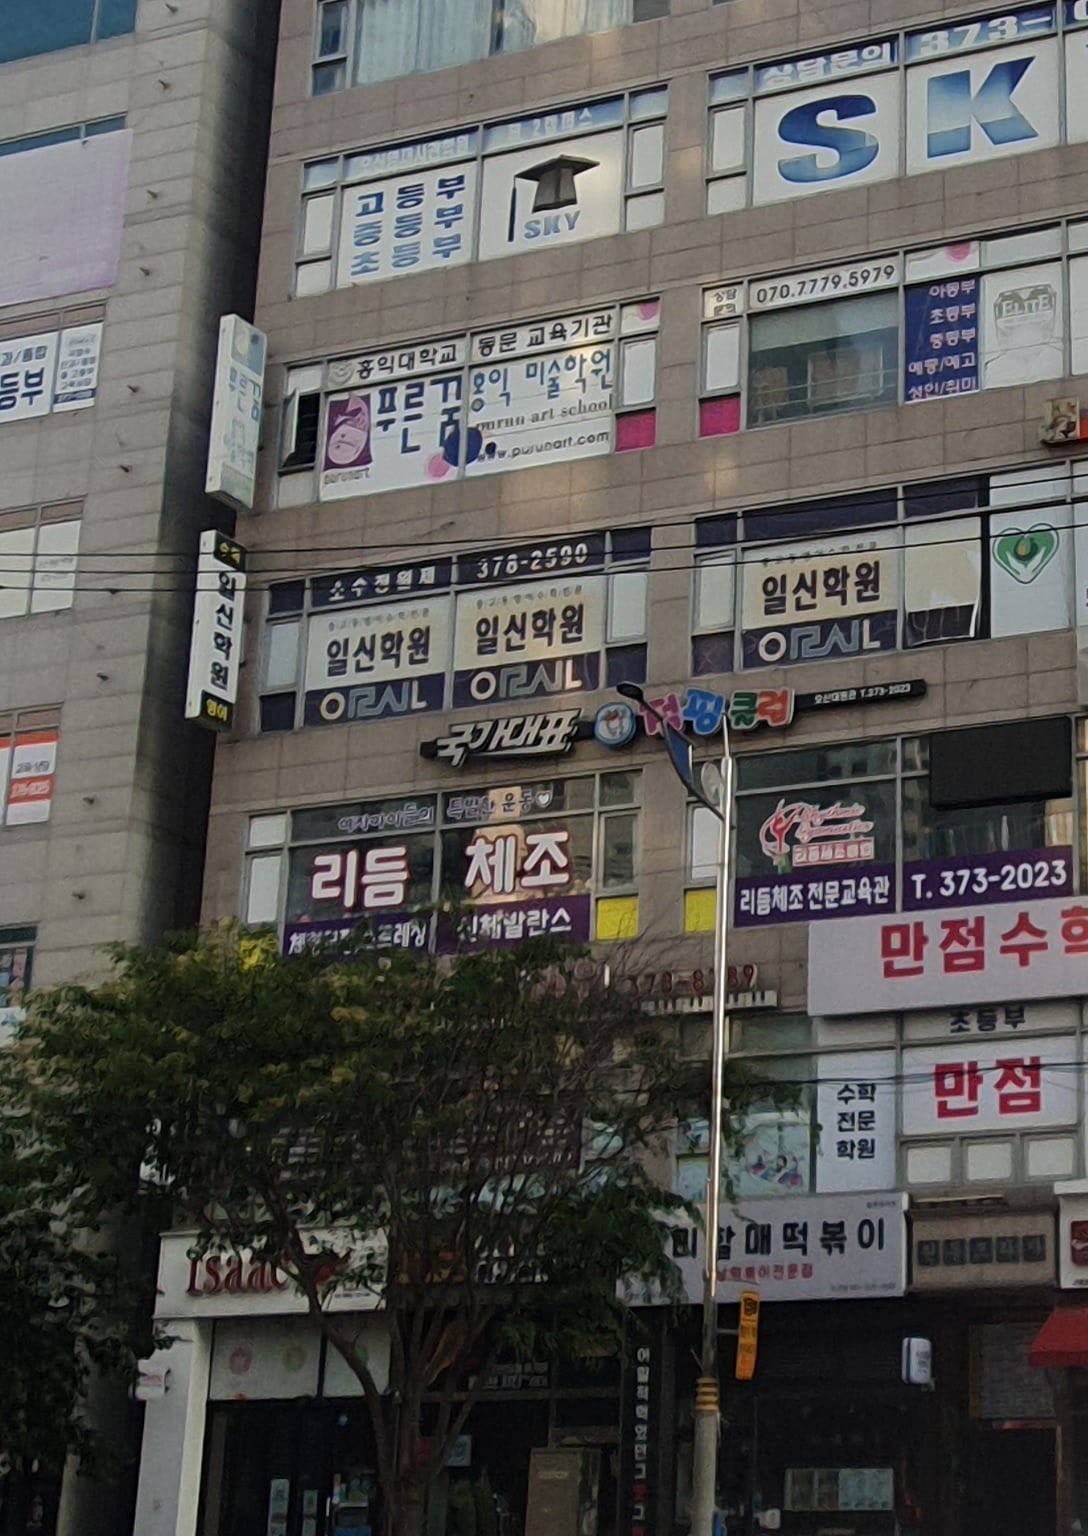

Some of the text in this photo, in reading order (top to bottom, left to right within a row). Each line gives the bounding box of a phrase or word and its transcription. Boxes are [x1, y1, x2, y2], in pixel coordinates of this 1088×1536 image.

[354, 173, 466, 218] 고등부
[353, 202, 465, 248] 중등부
[523, 209, 581, 241] SKY
[350, 231, 462, 277] 초등부
[356, 343, 458, 381] 홍익대학교
[526, 314, 614, 348] 교육기관
[525, 349, 613, 401] 미술학원
[530, 410, 555, 426] art
[560, 393, 614, 419] school
[760, 559, 883, 617] 일신학원
[325, 625, 431, 678] 일신학원
[474, 603, 586, 657] 일신학원
[434, 708, 584, 768] 국가대표
[310, 830, 571, 910] 리듬 체조
[939, 859, 1068, 899] 373-2023
[740, 874, 891, 916] 리듬체조 전문교육관
[948, 1004, 1028, 1034] 초등부
[836, 1081, 878, 1105] 수학
[932, 1054, 1043, 1120] 만점
[836, 1109, 877, 1134] 전문
[836, 1136, 877, 1162] 학원
